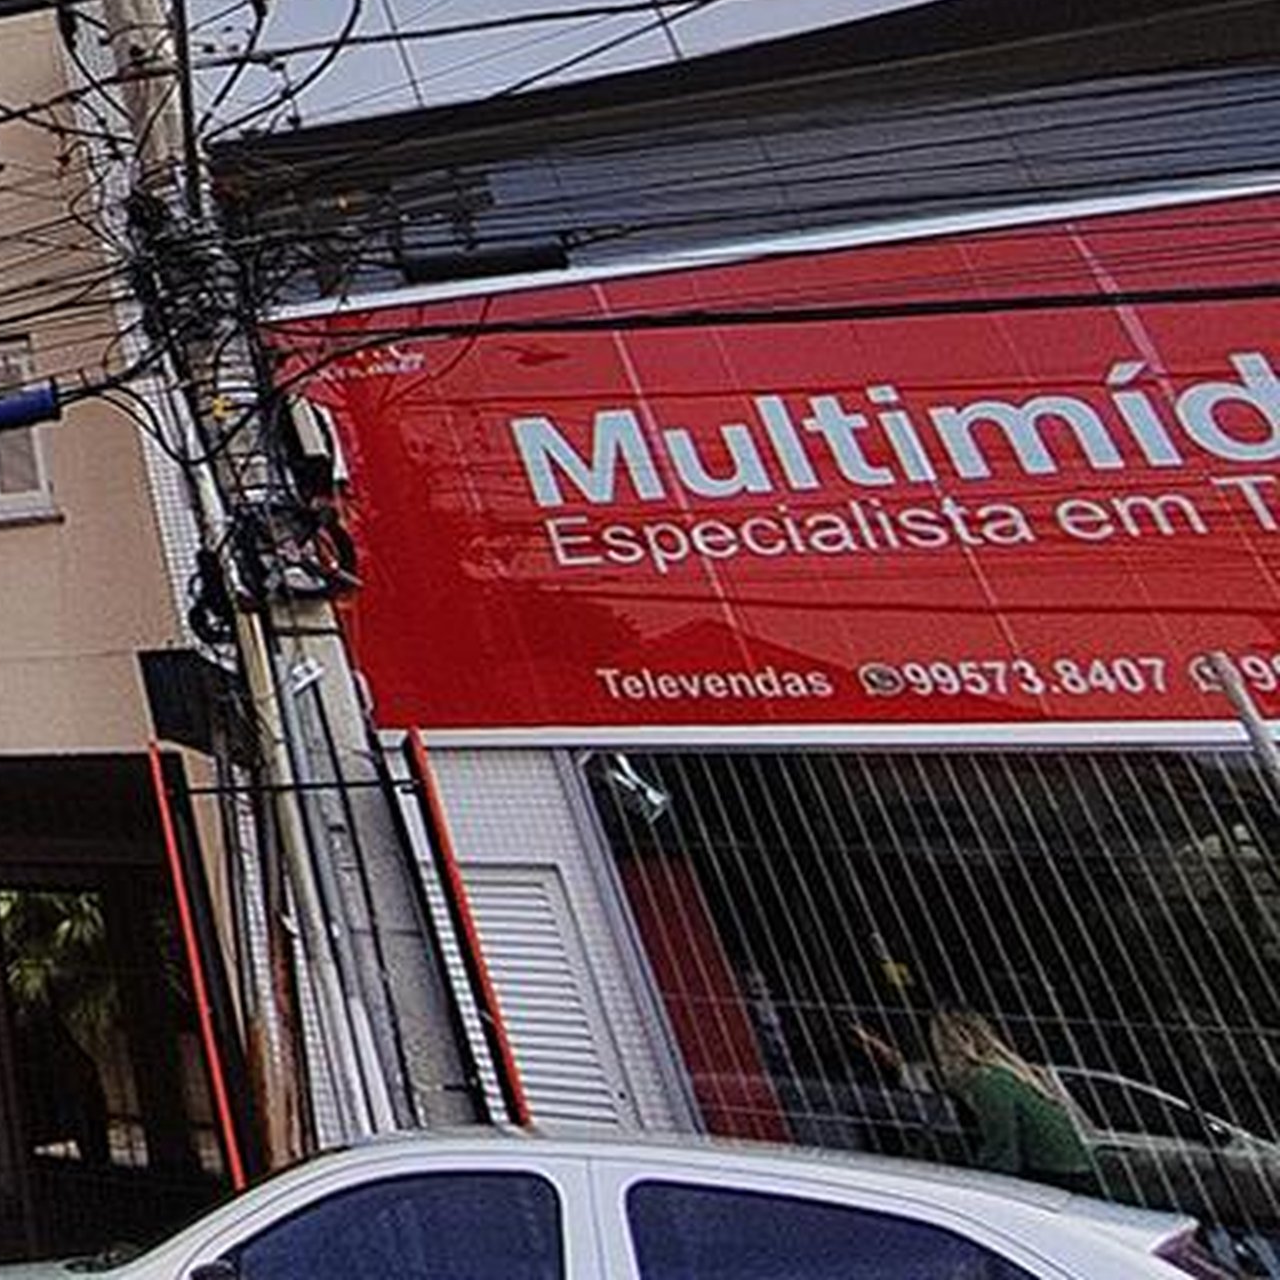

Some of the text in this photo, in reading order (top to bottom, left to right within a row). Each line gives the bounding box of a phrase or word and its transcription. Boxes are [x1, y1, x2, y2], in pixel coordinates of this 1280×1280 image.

[545, 495, 1037, 576] Especialista
[1054, 492, 1209, 541] em
[596, 666, 835, 700] Televendas
[903, 657, 1168, 697] 99573.8407
